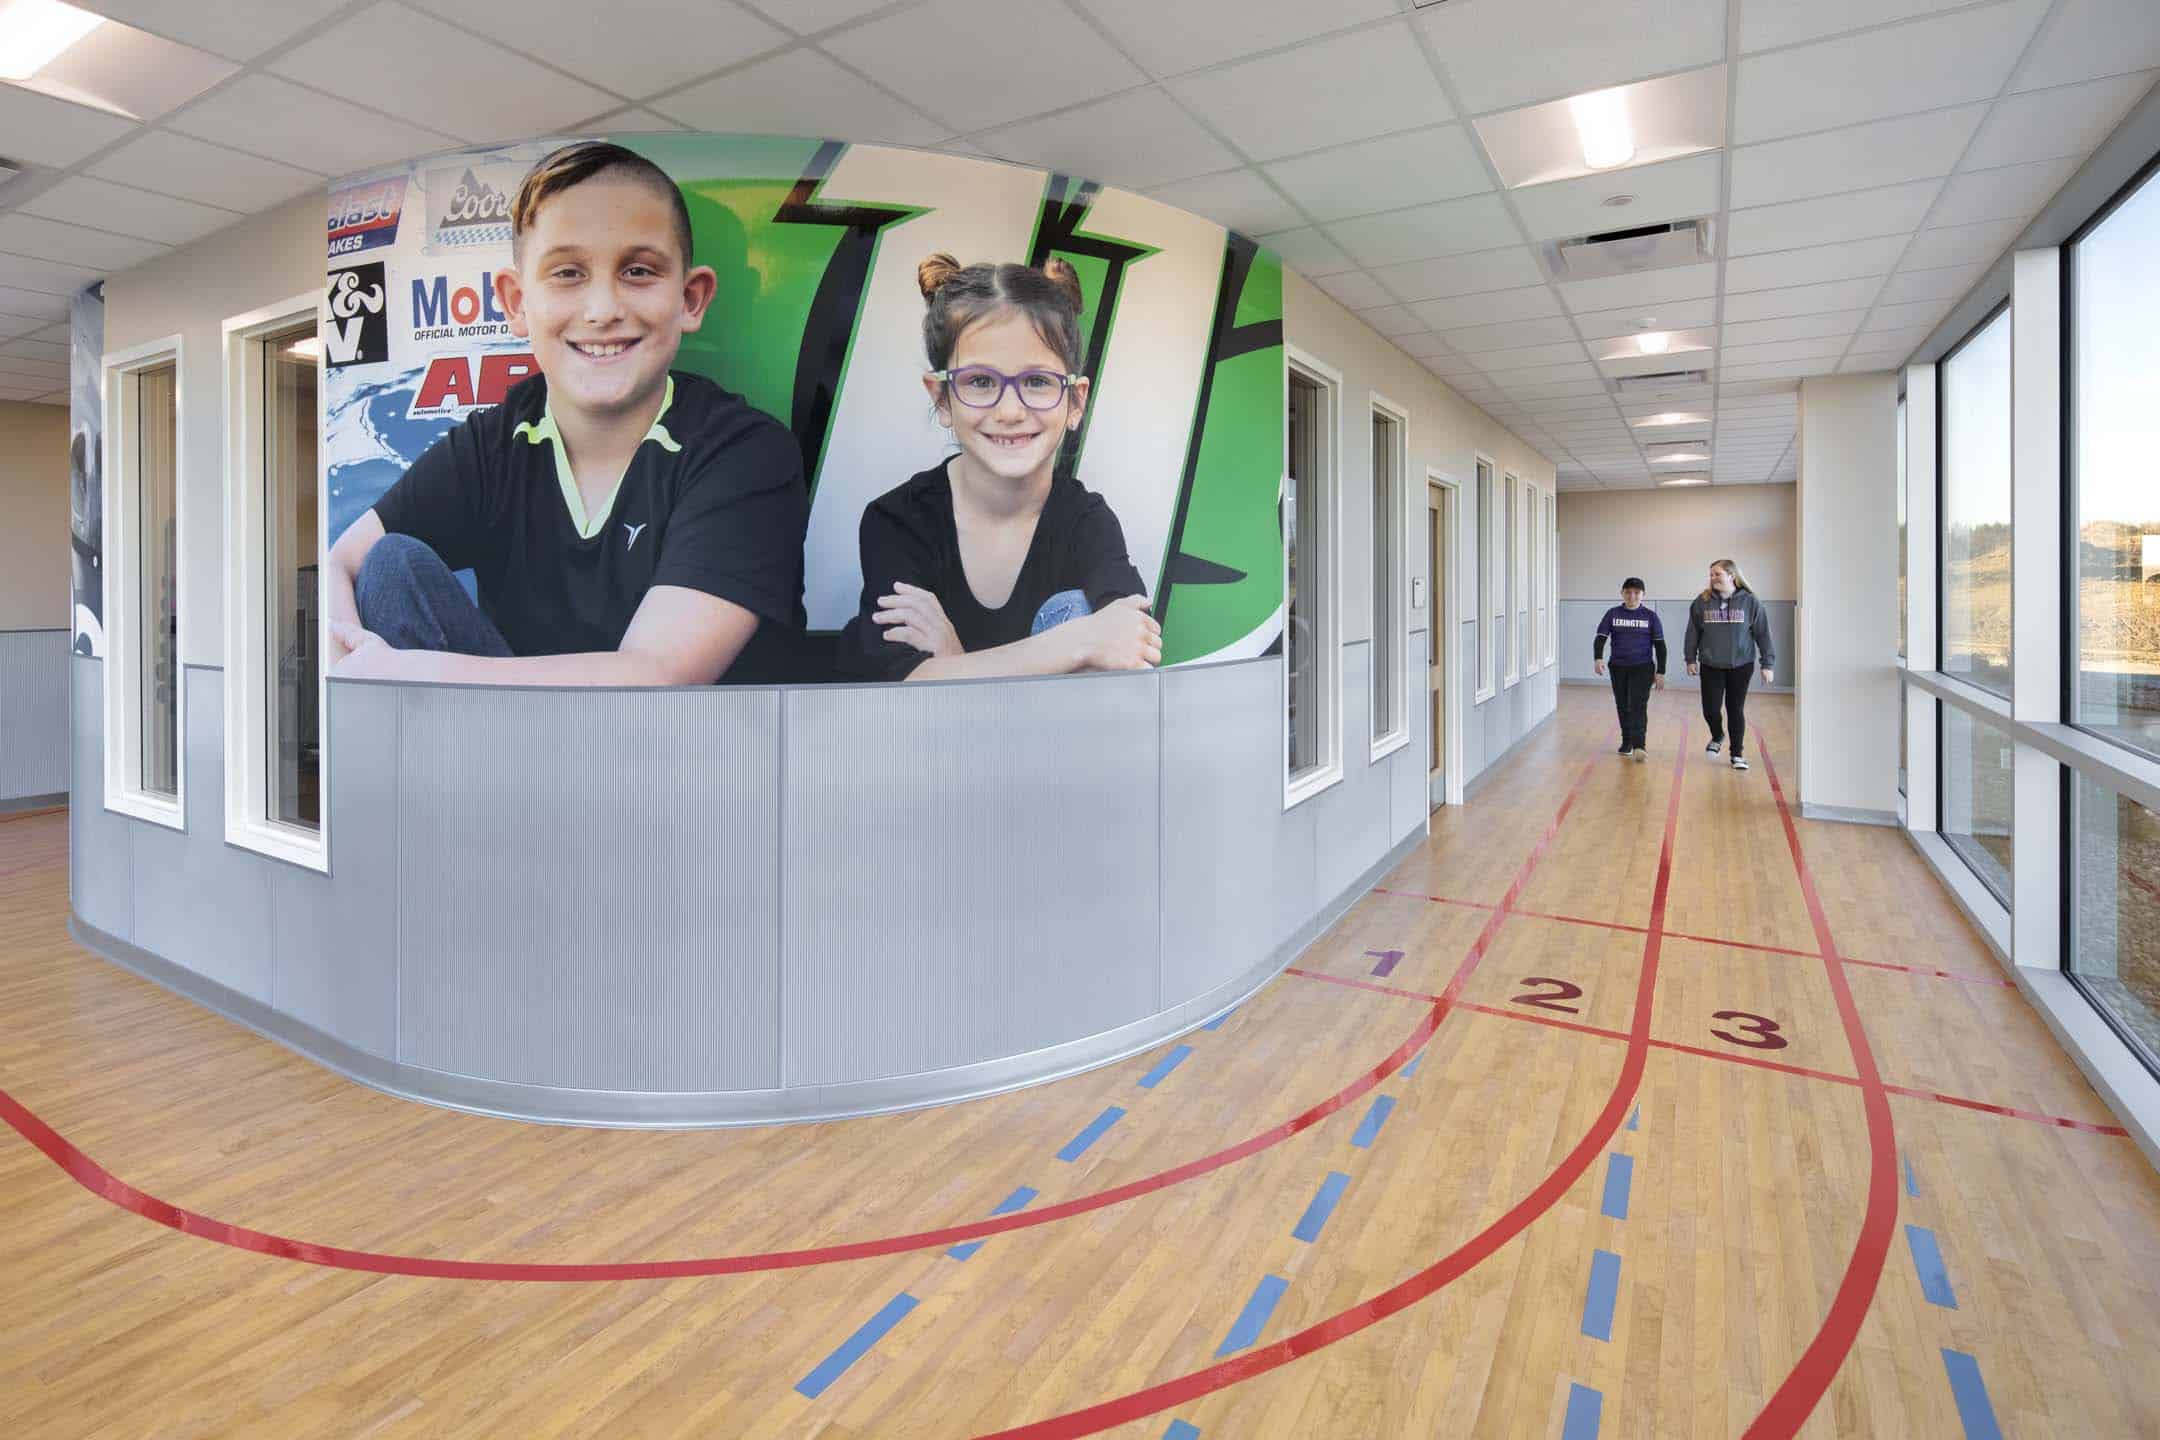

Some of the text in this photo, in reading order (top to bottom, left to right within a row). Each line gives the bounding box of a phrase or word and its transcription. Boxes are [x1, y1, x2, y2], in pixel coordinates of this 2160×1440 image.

[328, 234, 364, 255] AKES
[414, 328, 455, 341] OFFICIAL
[459, 325, 497, 337] MOTOR
[1612, 618, 1649, 629] LEXINGTON
[1363, 949, 1405, 978] 1
[1510, 976, 1584, 1014] 2
[1710, 1010, 1788, 1050] 3
